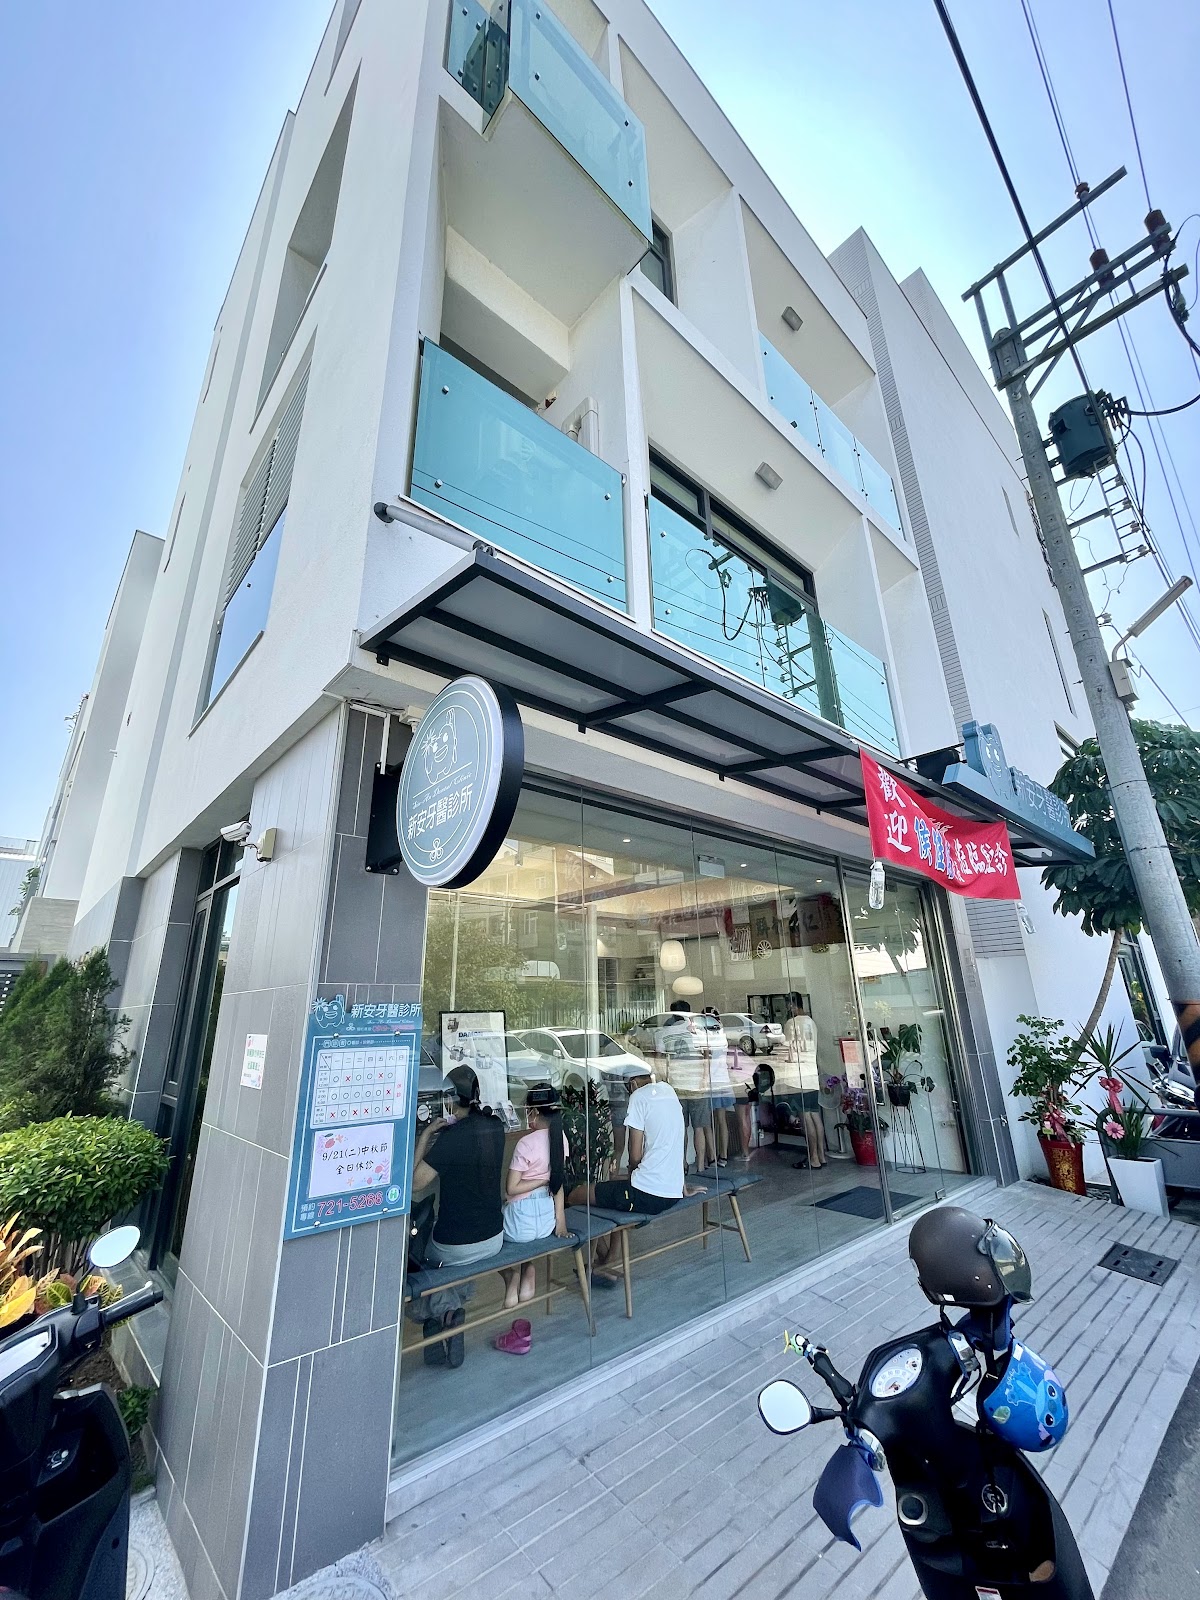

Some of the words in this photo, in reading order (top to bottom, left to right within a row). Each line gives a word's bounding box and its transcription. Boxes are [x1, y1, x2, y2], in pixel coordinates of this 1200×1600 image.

[407, 783, 473, 841] 新安牙醫診所
[877, 765, 912, 853] 歡迎
[350, 1003, 422, 1019] 新安牙醫診所
[322, 1142, 388, 1161] 9/21(二)中秋節
[335, 1160, 374, 1175] 全日休診
[317, 1191, 383, 1218] 721-5266
